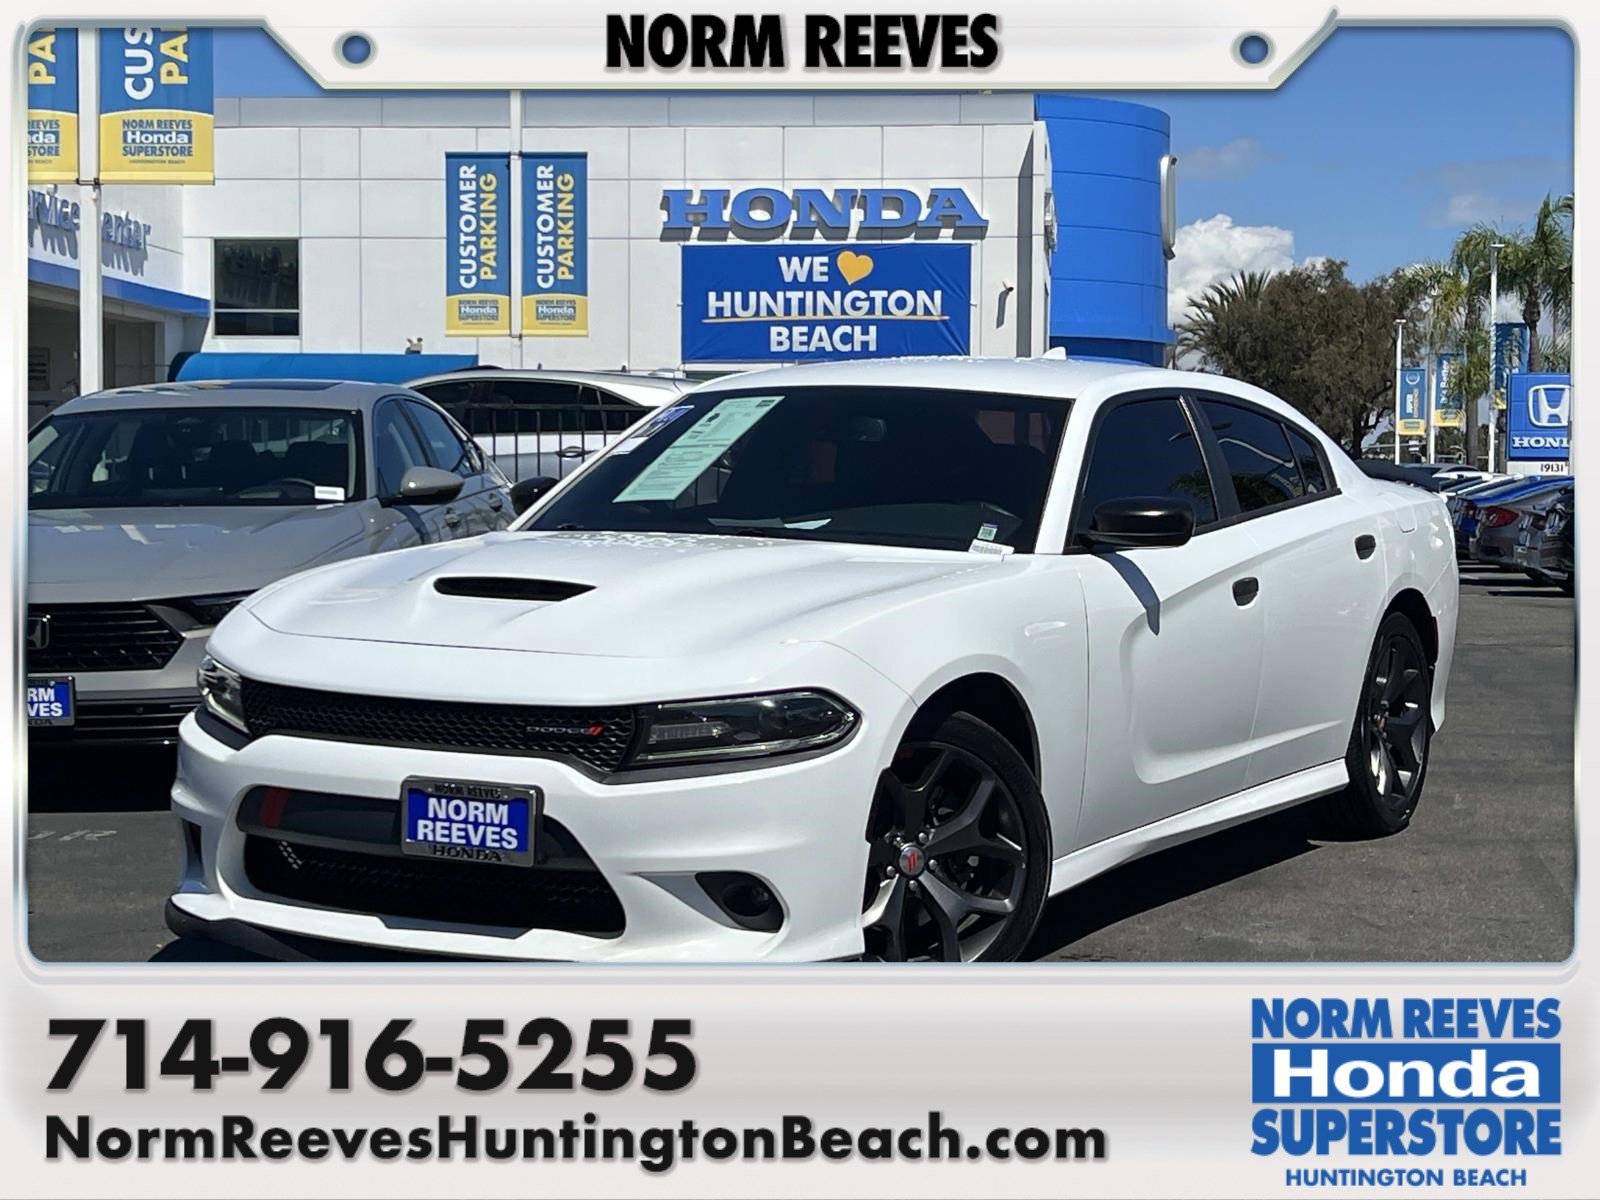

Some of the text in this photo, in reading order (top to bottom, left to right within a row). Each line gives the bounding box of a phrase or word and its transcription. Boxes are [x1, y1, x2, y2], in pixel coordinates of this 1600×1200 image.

[29, 28, 56, 85] PA
[160, 28, 189, 85] PA
[122, 119, 193, 129] NORM REEVES
[127, 131, 189, 144] Honda
[122, 146, 193, 156] SUPERSTORE
[459, 164, 478, 289] CUSTOMER
[479, 173, 497, 280] PARKING
[536, 164, 555, 289] CUSTOMER
[557, 173, 575, 280] PARKING
[660, 188, 989, 237] HONDA
[101, 211, 151, 249] enter
[778, 256, 829, 283] WE
[707, 289, 942, 317] HUNTINGTON
[769, 325, 877, 352] BEACH
[526, 726, 592, 735] DODGE
[428, 798, 509, 825] NORM
[417, 819, 518, 850] REEVES
[432, 845, 502, 862] HONDA
